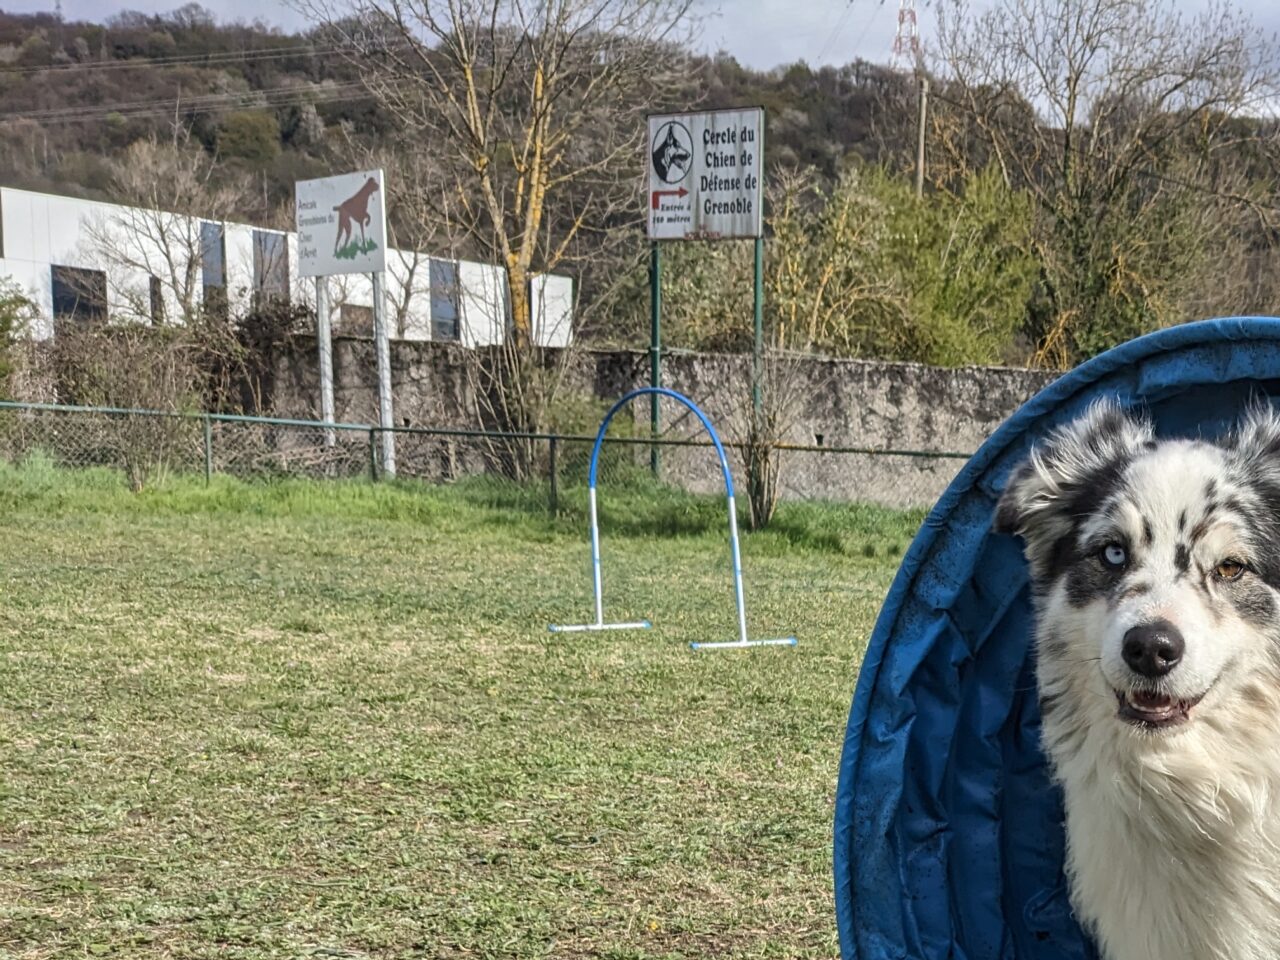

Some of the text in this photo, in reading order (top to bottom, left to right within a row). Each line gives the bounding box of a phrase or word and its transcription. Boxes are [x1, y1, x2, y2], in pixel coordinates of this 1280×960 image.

[703, 125, 755, 145] Cercle du
[705, 150, 752, 168] Chien de
[700, 171, 757, 193] Défense de
[703, 198, 753, 215] Grenoble
